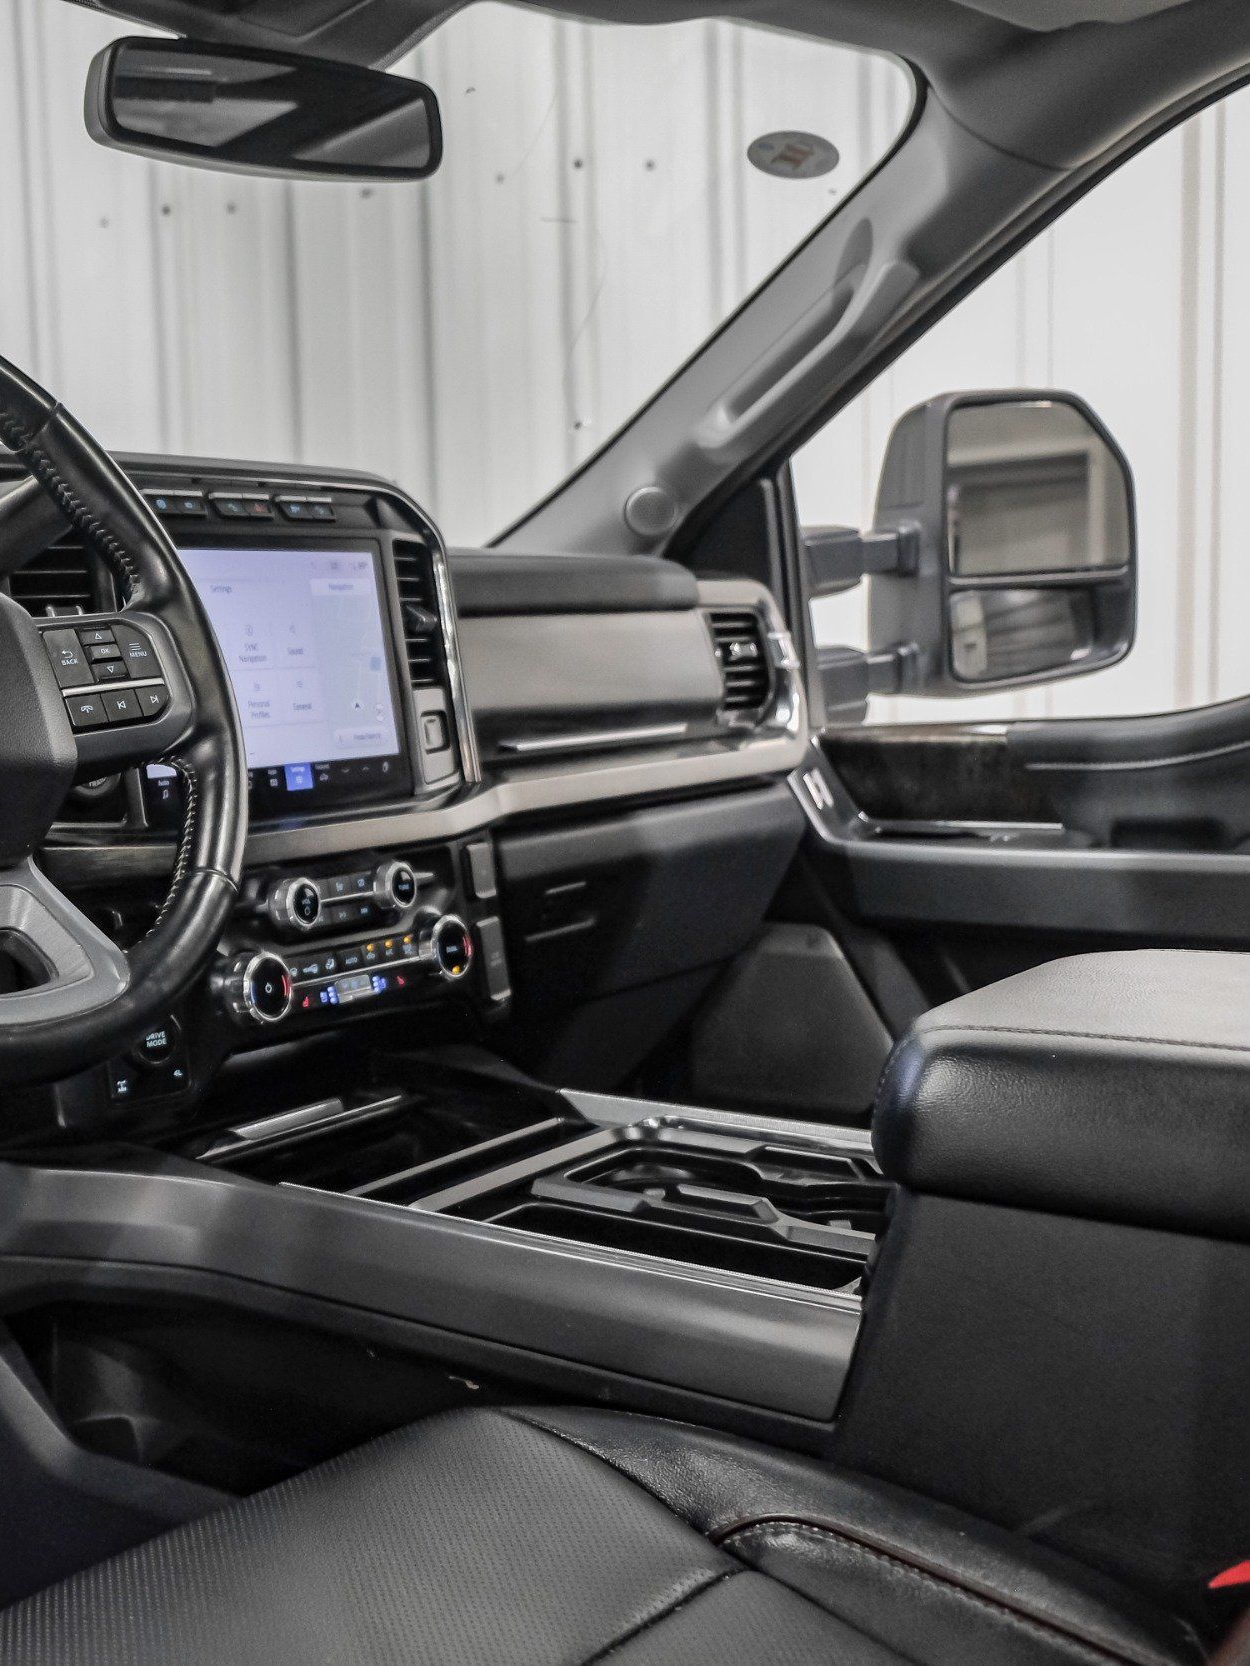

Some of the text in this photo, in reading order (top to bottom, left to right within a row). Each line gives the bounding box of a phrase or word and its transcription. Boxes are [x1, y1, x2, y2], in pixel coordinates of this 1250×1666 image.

[61, 658, 78, 666] BACK
[146, 1030, 166, 1040] DRIVE
[146, 1038, 167, 1048] MODE
